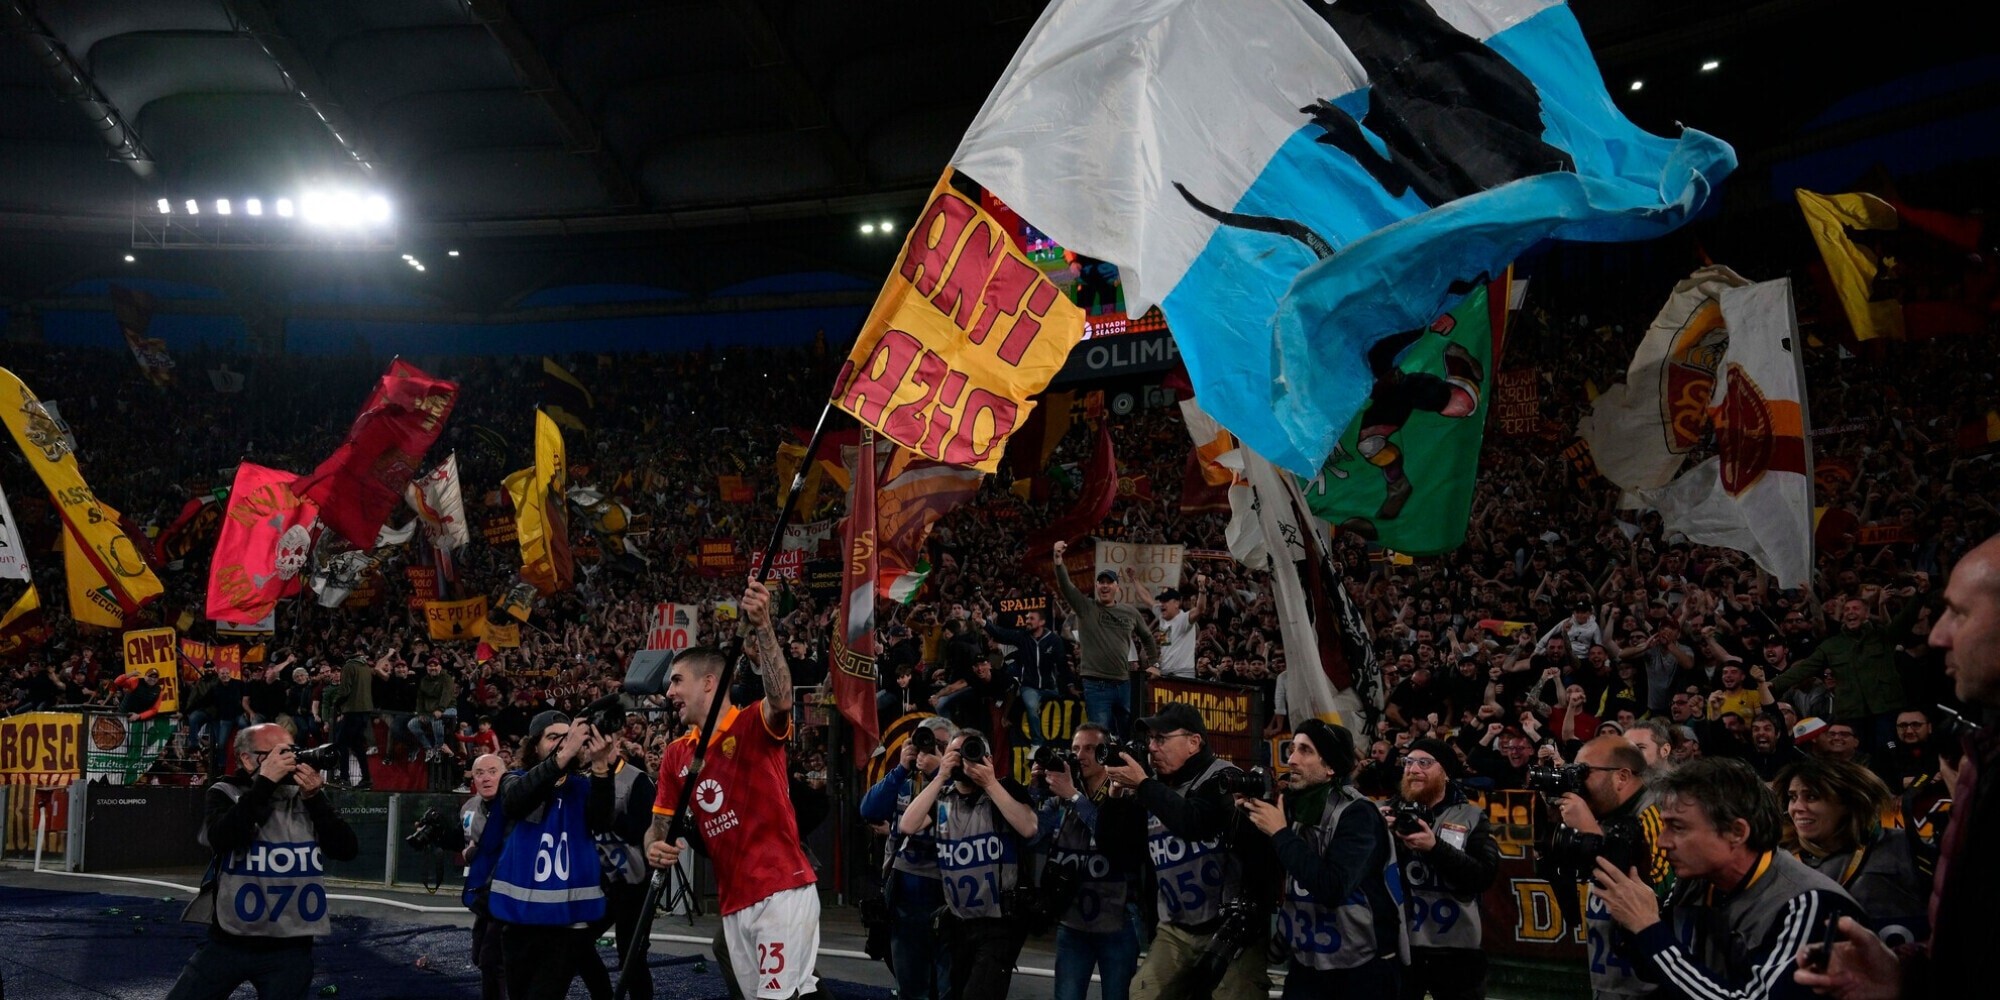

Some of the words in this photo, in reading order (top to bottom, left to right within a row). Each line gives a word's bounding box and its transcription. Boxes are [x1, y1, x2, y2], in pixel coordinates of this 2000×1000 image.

[1095, 320, 1126, 329] RIYADH
[1095, 327, 1126, 336] SEASON
[703, 543, 732, 554] ANDREA
[1104, 547, 1127, 563] IO
[1137, 547, 1177, 563] CHE
[702, 555, 735, 566] PRESENTE
[408, 568, 435, 577] VOGLIO
[750, 565, 799, 580] GDERE
[414, 579, 432, 588] SOLO
[428, 607, 444, 621] SE
[467, 604, 482, 617] FA
[1000, 597, 1046, 612] SPALLE
[658, 603, 675, 626] TI
[648, 629, 687, 651] AMO
[704, 809, 736, 829] RIYADH
[706, 818, 739, 838] SEASON
[534, 832, 570, 883] 60
[235, 883, 326, 922] 070
[758, 942, 785, 974] 23
